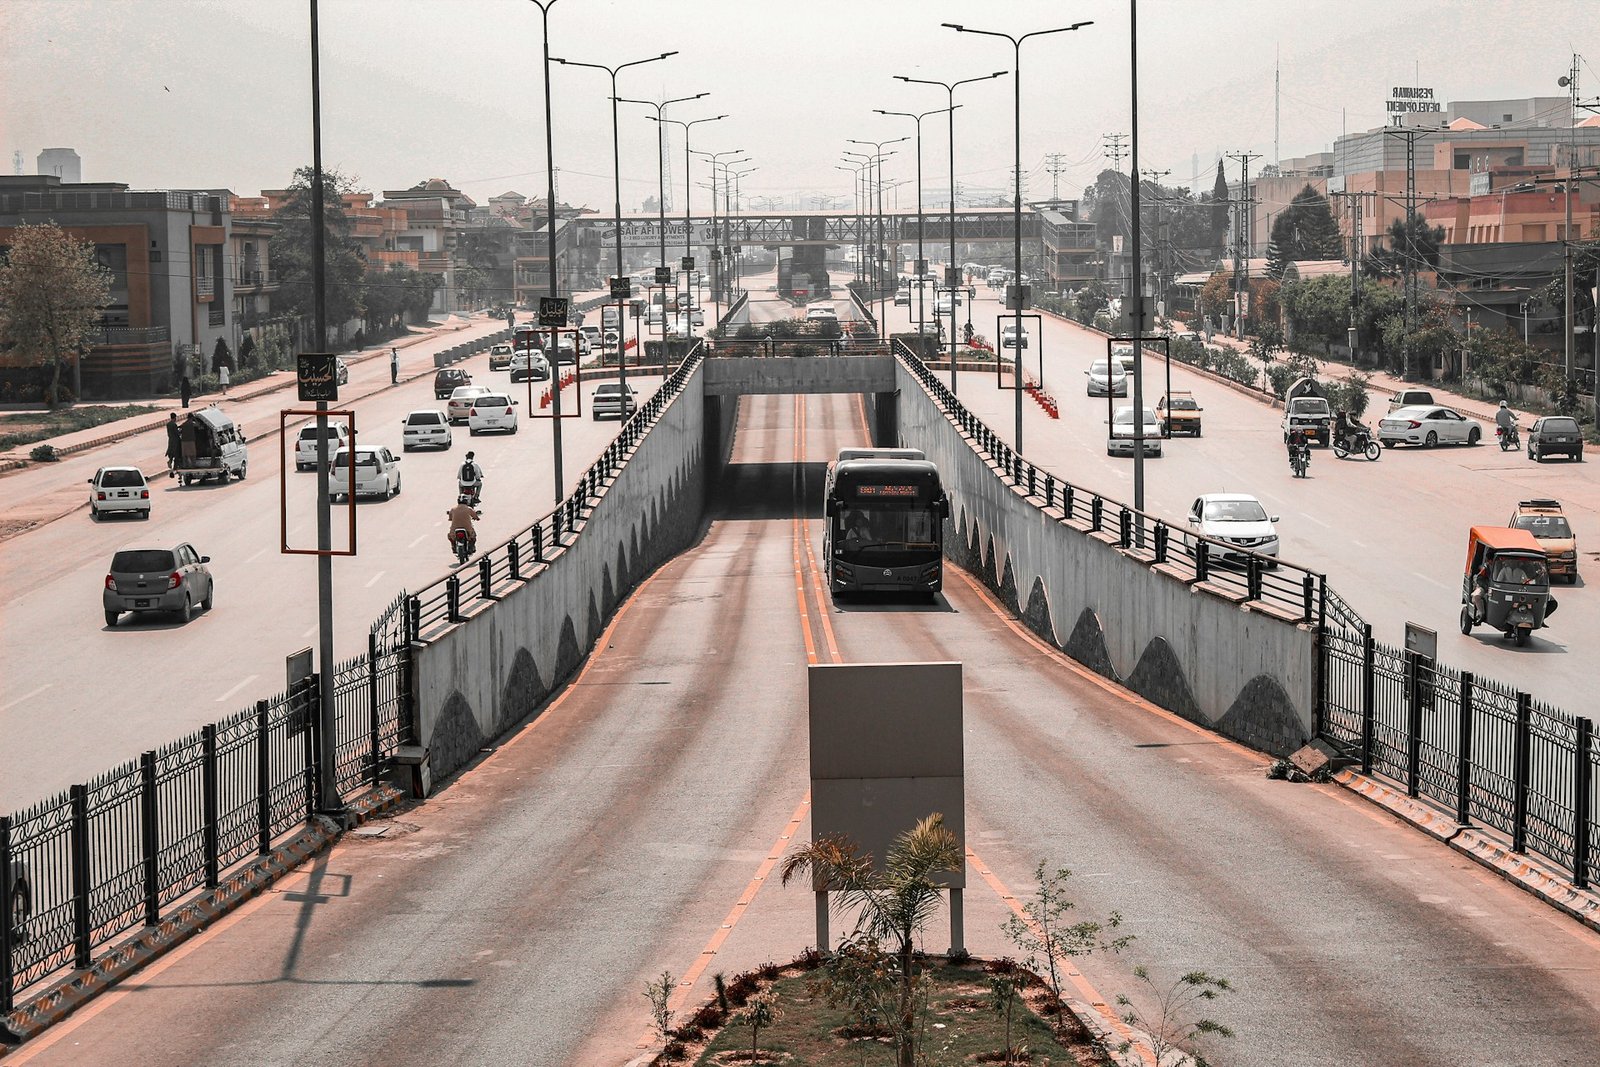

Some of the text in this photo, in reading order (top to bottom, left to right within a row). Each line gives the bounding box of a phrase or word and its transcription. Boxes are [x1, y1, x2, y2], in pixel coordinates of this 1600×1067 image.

[620, 226, 639, 235] SAIF
[641, 226, 655, 235] AFI
[656, 225, 688, 235] TOWER
